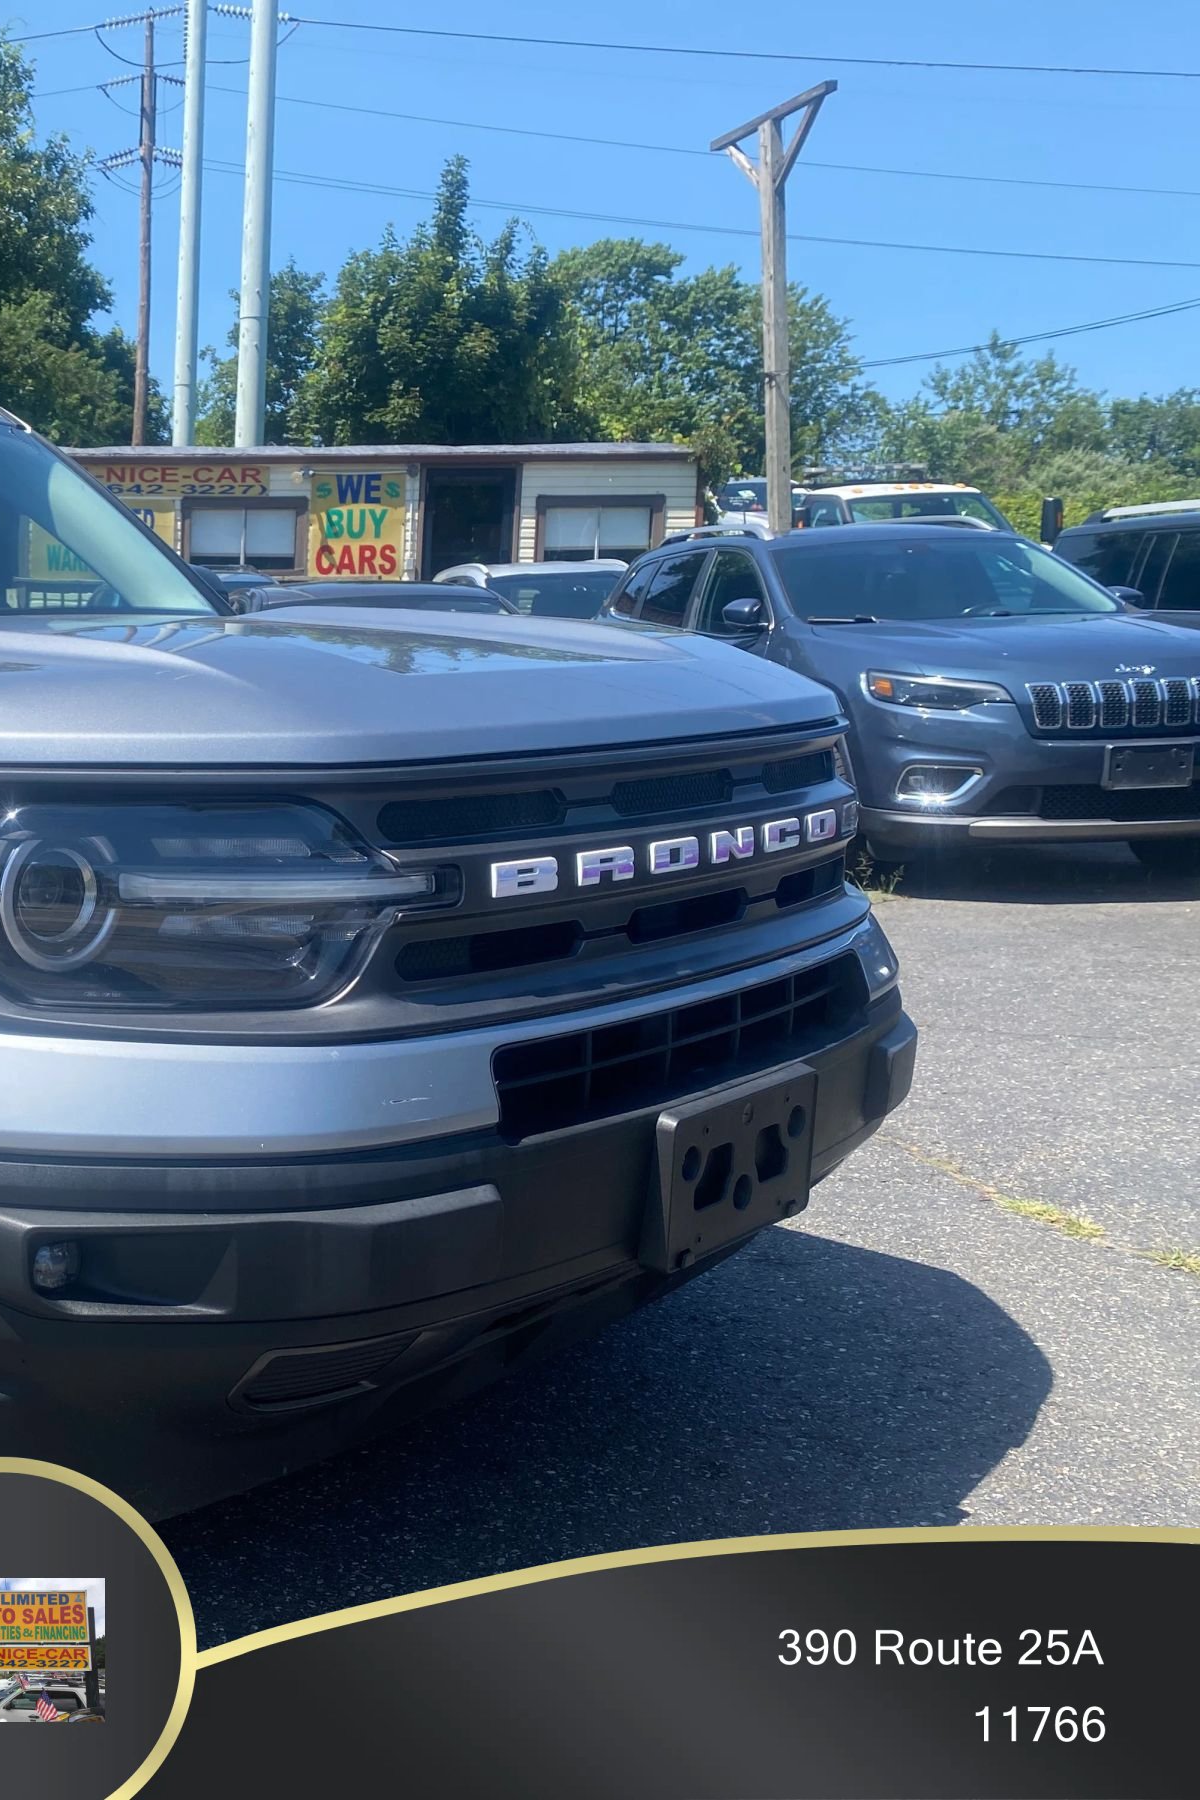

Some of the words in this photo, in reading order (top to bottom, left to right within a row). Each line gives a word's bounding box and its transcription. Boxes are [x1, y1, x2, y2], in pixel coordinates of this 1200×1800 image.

[83, 467, 262, 484] -NICE-CAR
[336, 474, 382, 504] WE
[324, 508, 389, 539] BUY
[315, 543, 397, 575] CARS
[490, 808, 837, 899] BRONCO
